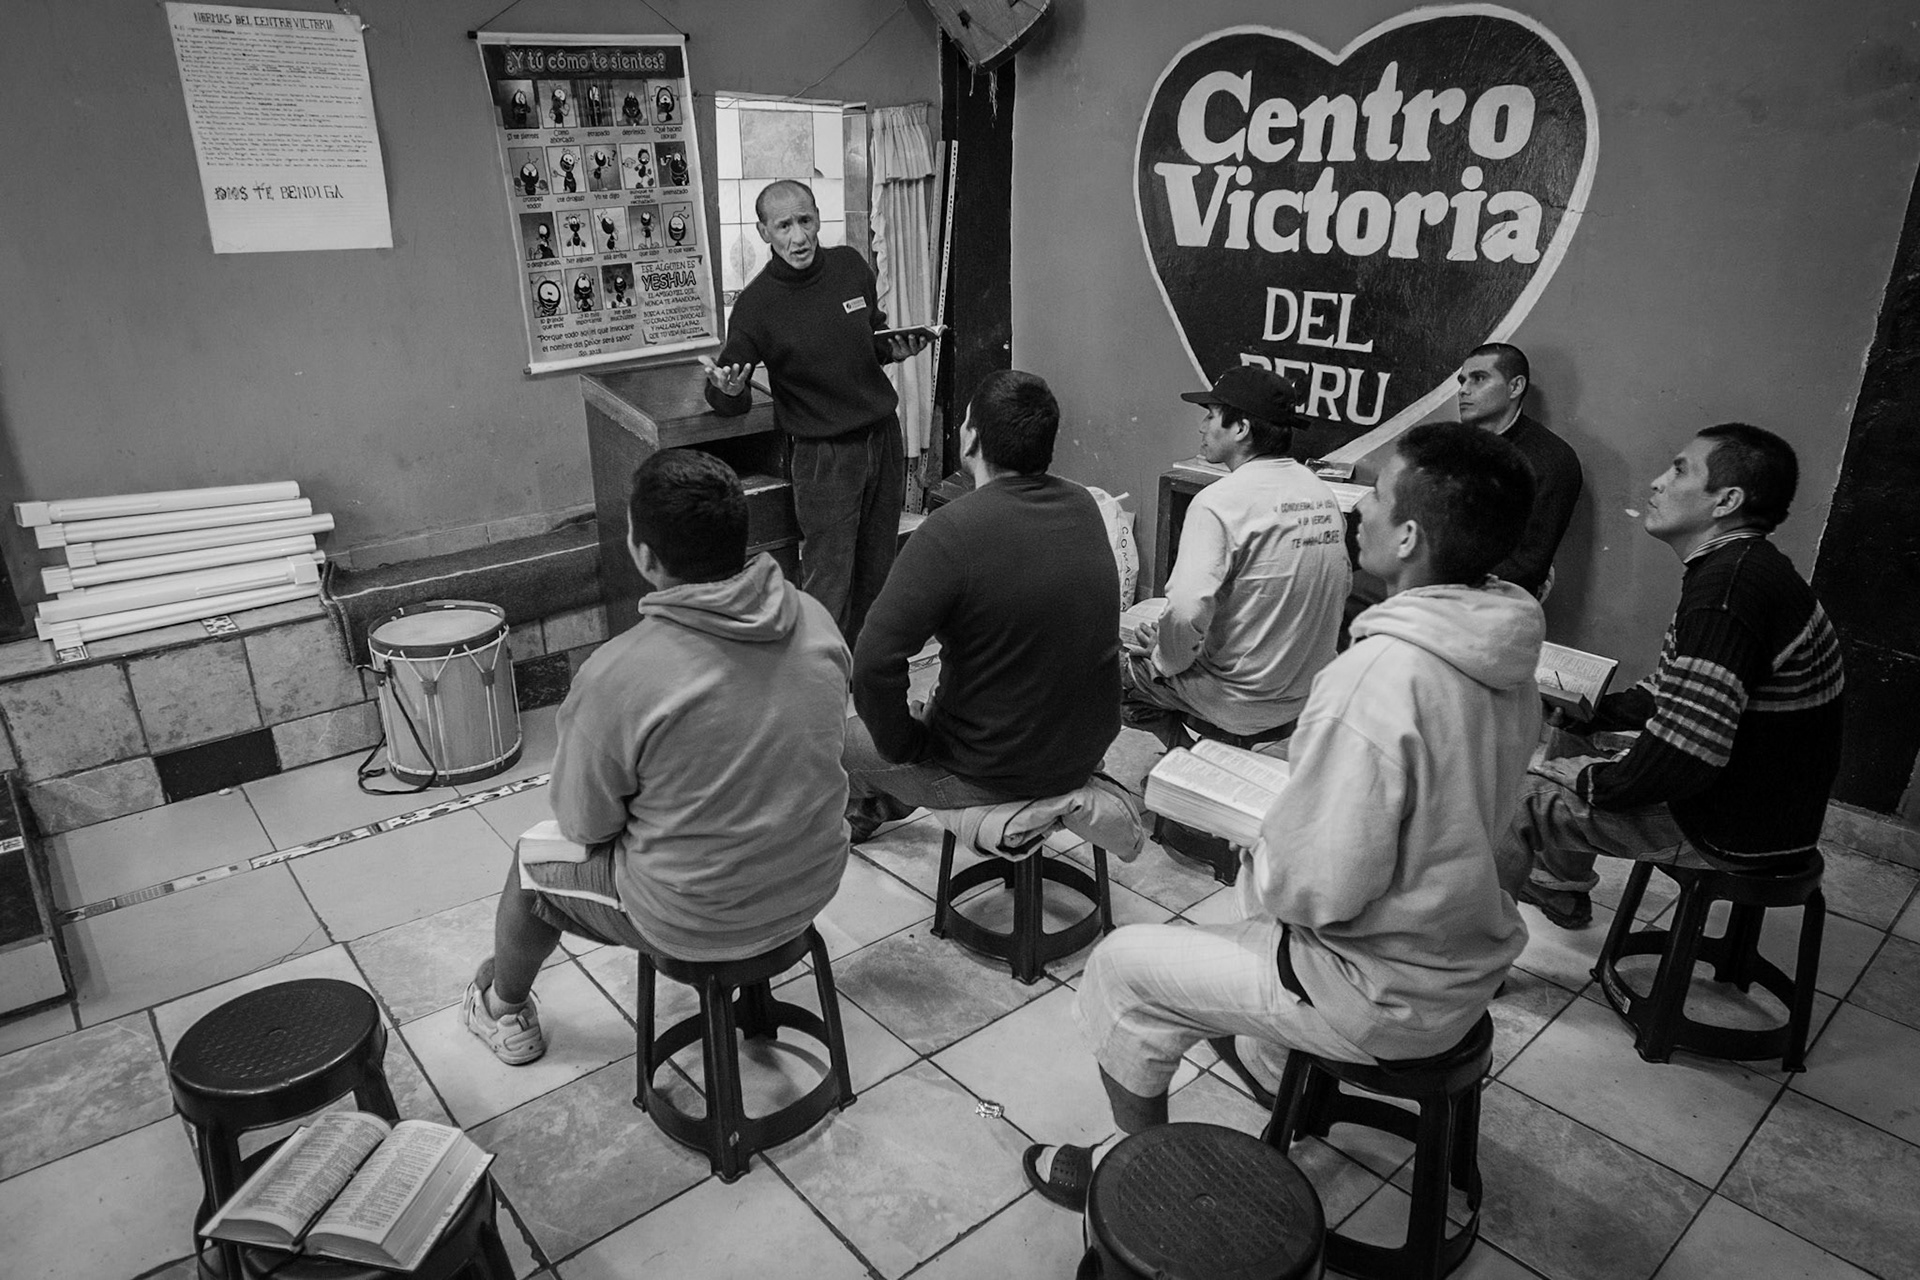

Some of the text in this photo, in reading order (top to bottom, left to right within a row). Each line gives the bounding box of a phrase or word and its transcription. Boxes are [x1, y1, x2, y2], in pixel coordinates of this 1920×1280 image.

[528, 51, 544, 69] tú
[548, 52, 588, 69] cómo
[592, 52, 608, 69] te
[611, 51, 665, 69] sientes?
[1177, 60, 1535, 164] Centro
[280, 185, 344, 200] BENDIGA
[1154, 162, 1542, 263] Victoria
[641, 260, 696, 273] ESE ALGUIEN ES
[641, 270, 696, 291] YESHUA
[1262, 287, 1373, 353] DEL
[597, 327, 608, 335] que
[549, 342, 573, 351] nombre
